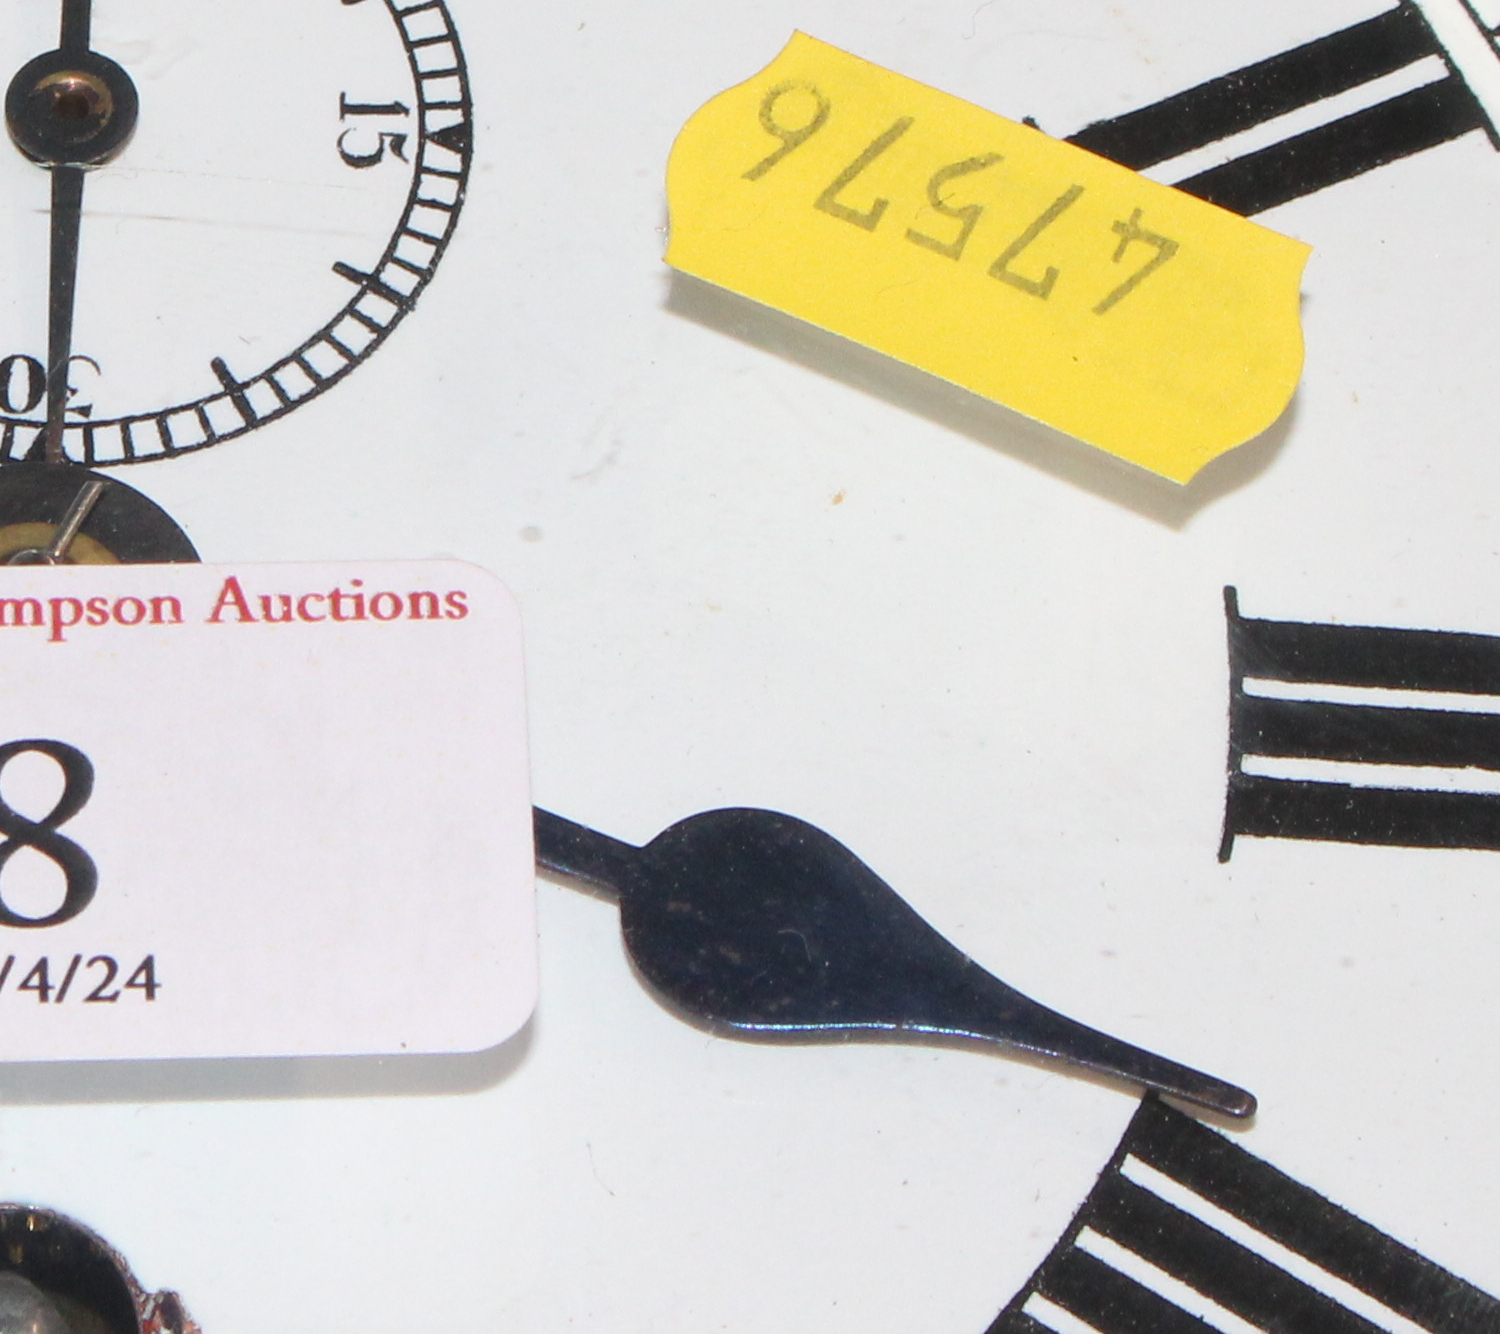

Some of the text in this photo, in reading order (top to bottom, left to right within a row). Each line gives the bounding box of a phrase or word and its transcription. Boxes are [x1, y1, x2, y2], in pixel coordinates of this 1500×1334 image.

[336, 90, 409, 171] 15
[741, 78, 1181, 316] 47576
[205, 575, 470, 624] Auctions
